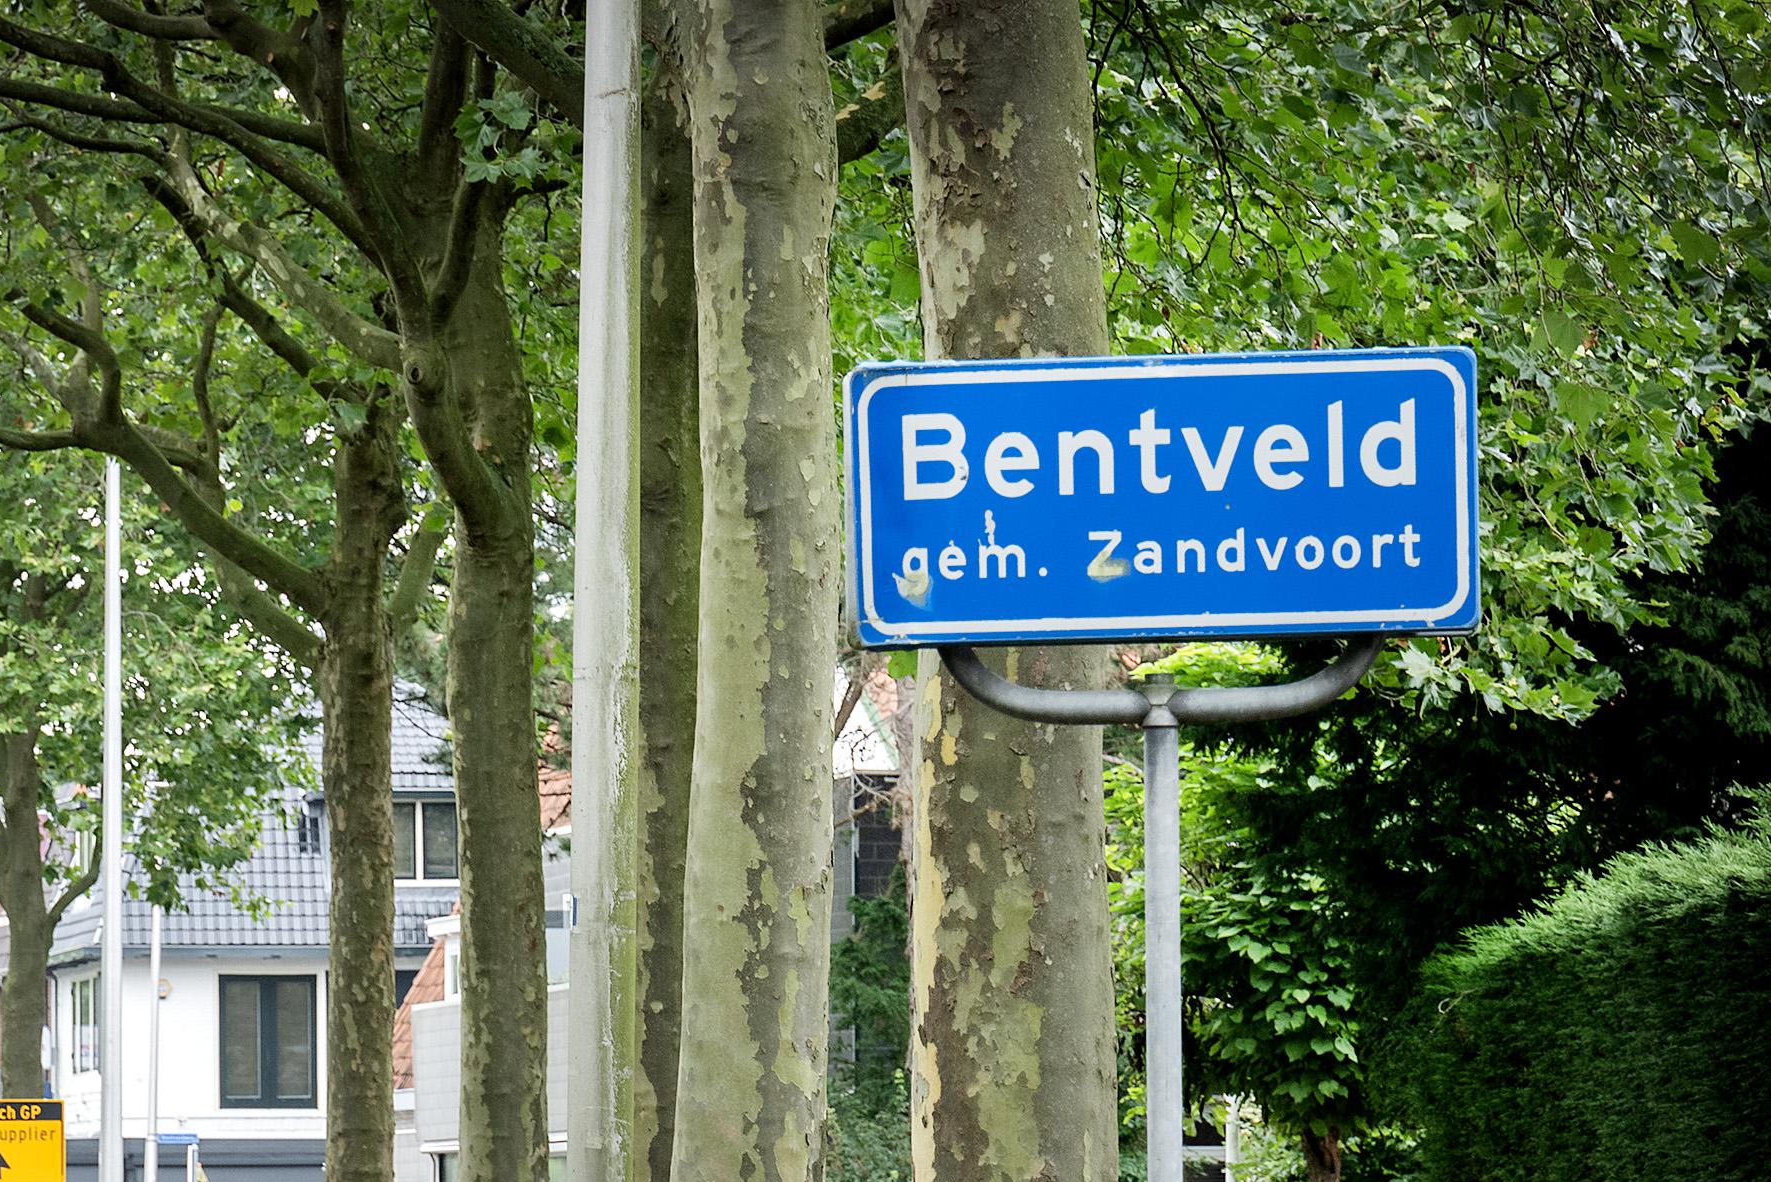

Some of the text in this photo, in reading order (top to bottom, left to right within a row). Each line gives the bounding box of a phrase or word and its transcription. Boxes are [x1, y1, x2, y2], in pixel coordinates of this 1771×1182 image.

[901, 397, 1418, 501] Bentveld
[893, 523, 1422, 602] gem. Zandvoort
[20, 1105, 42, 1120] GP
